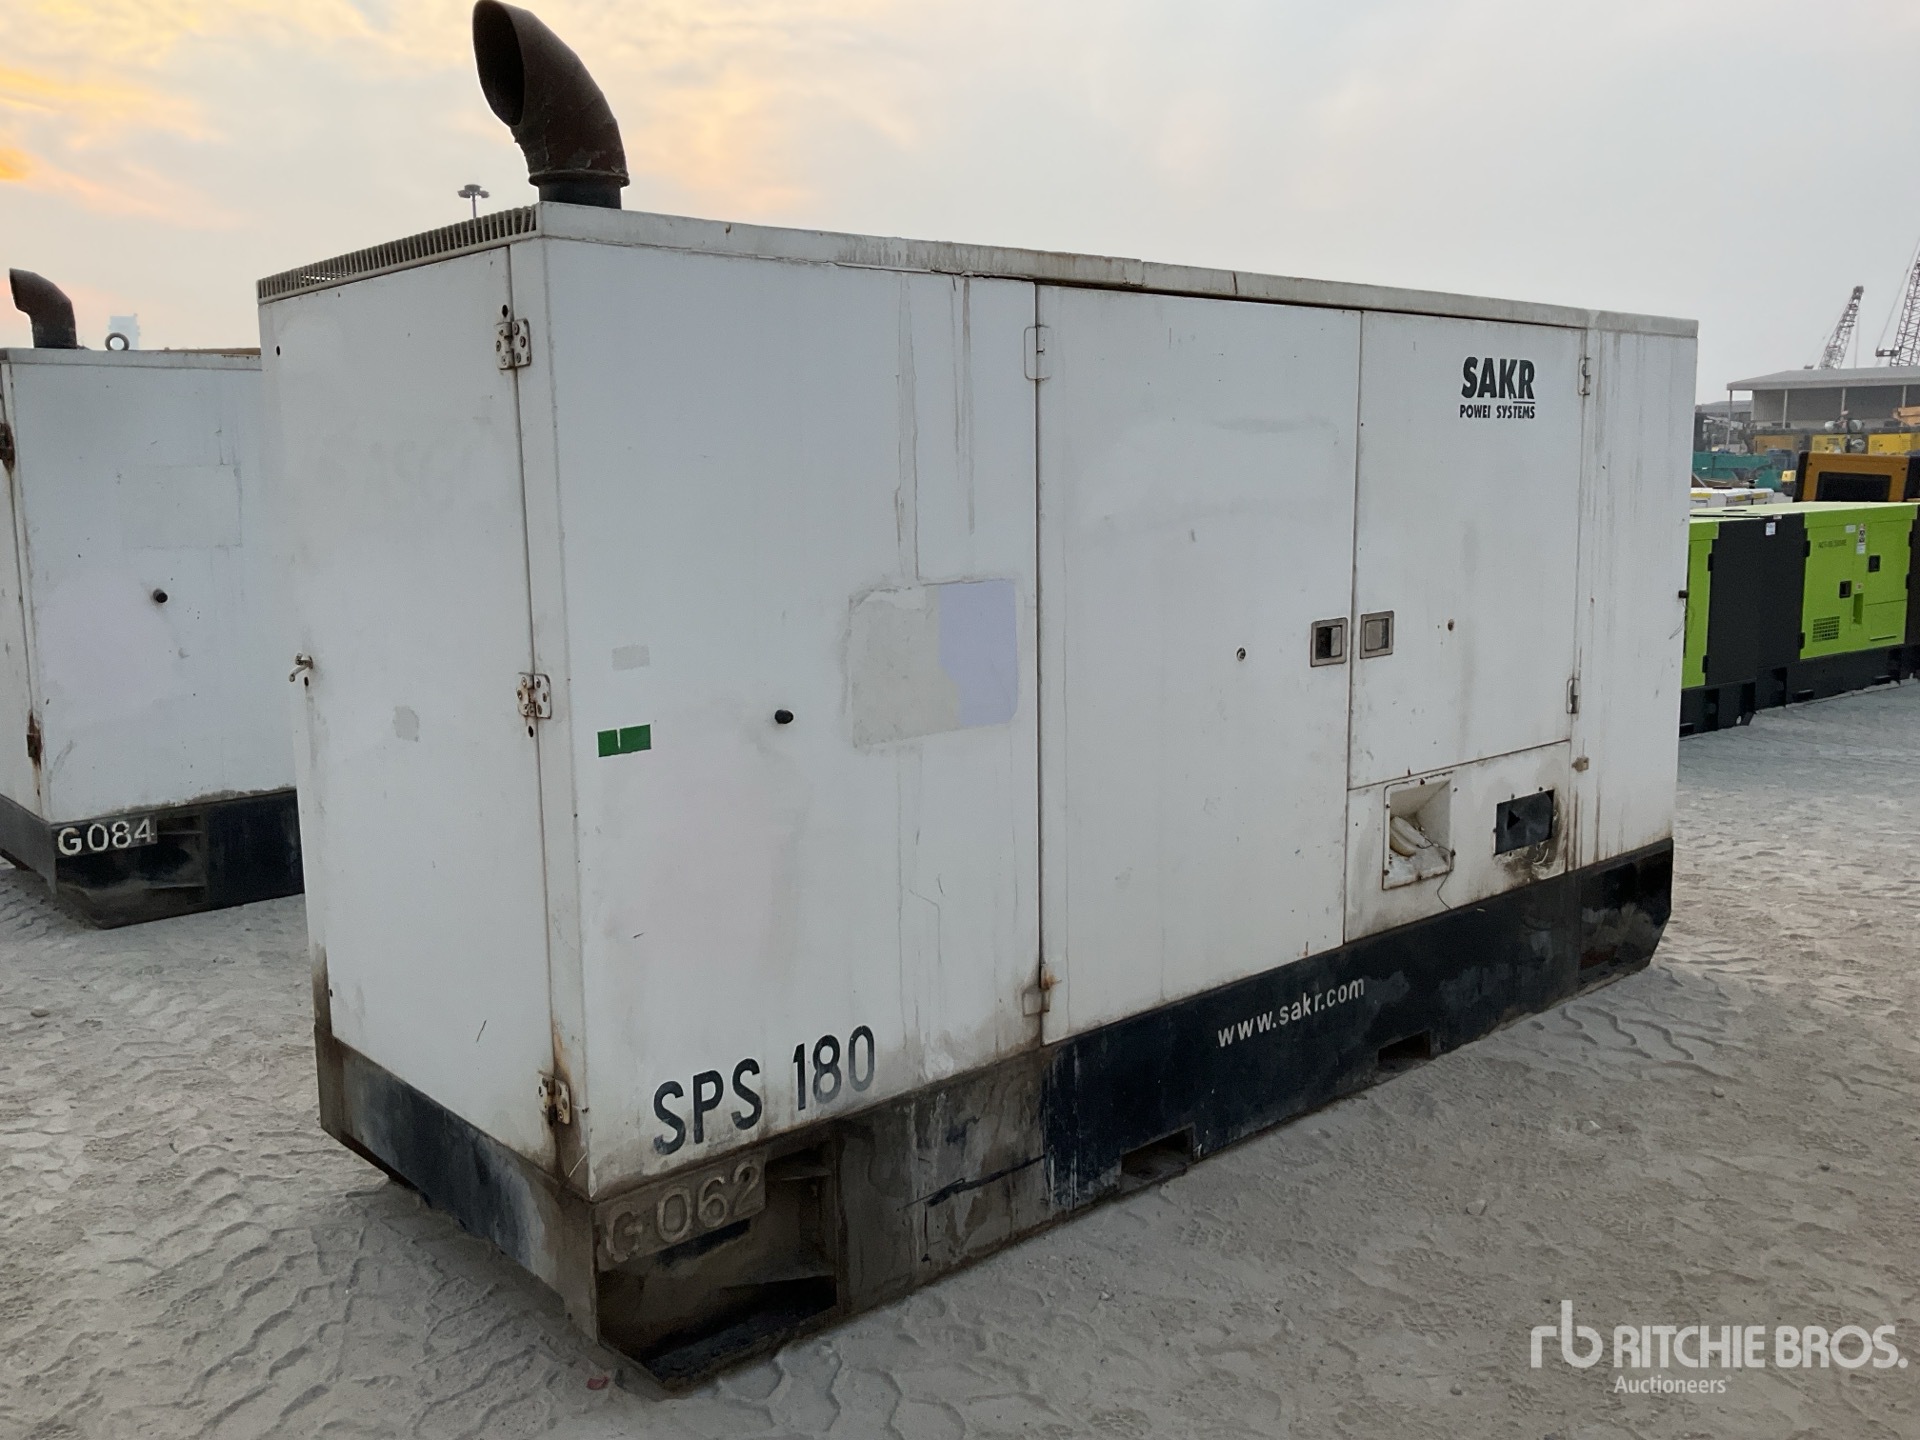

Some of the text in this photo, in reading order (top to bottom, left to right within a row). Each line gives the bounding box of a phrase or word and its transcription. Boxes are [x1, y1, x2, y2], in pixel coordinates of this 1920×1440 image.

[1461, 356, 1535, 400] SAKR
[1496, 405, 1535, 419] SYSTEMS
[57, 818, 156, 856] G084
[1217, 978, 1365, 1048] www.sakr.com
[653, 1025, 875, 1155] SPS 180
[605, 1161, 761, 1264] G062
